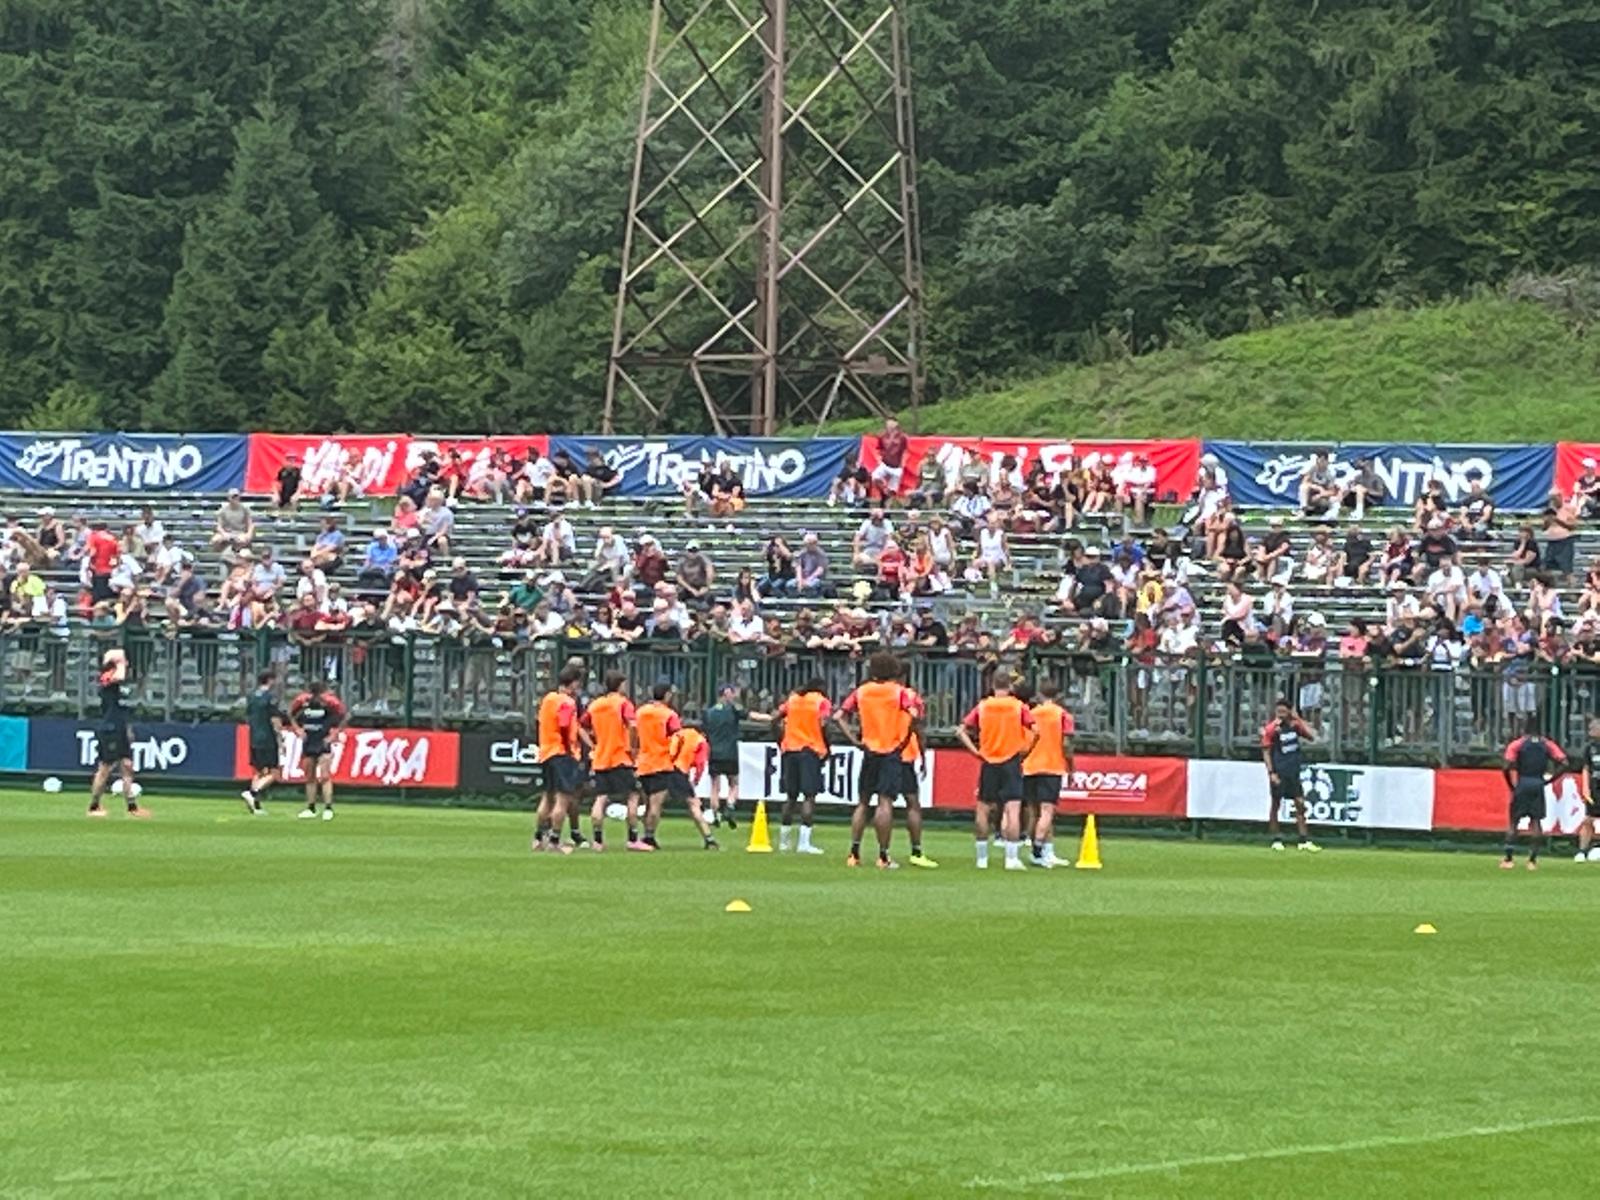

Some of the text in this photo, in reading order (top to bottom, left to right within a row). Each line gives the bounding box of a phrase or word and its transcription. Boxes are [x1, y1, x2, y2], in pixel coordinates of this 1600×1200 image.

[60, 439, 202, 489] TRENTINO
[76, 730, 187, 772] TRTINO
[350, 731, 429, 785] FASSA
